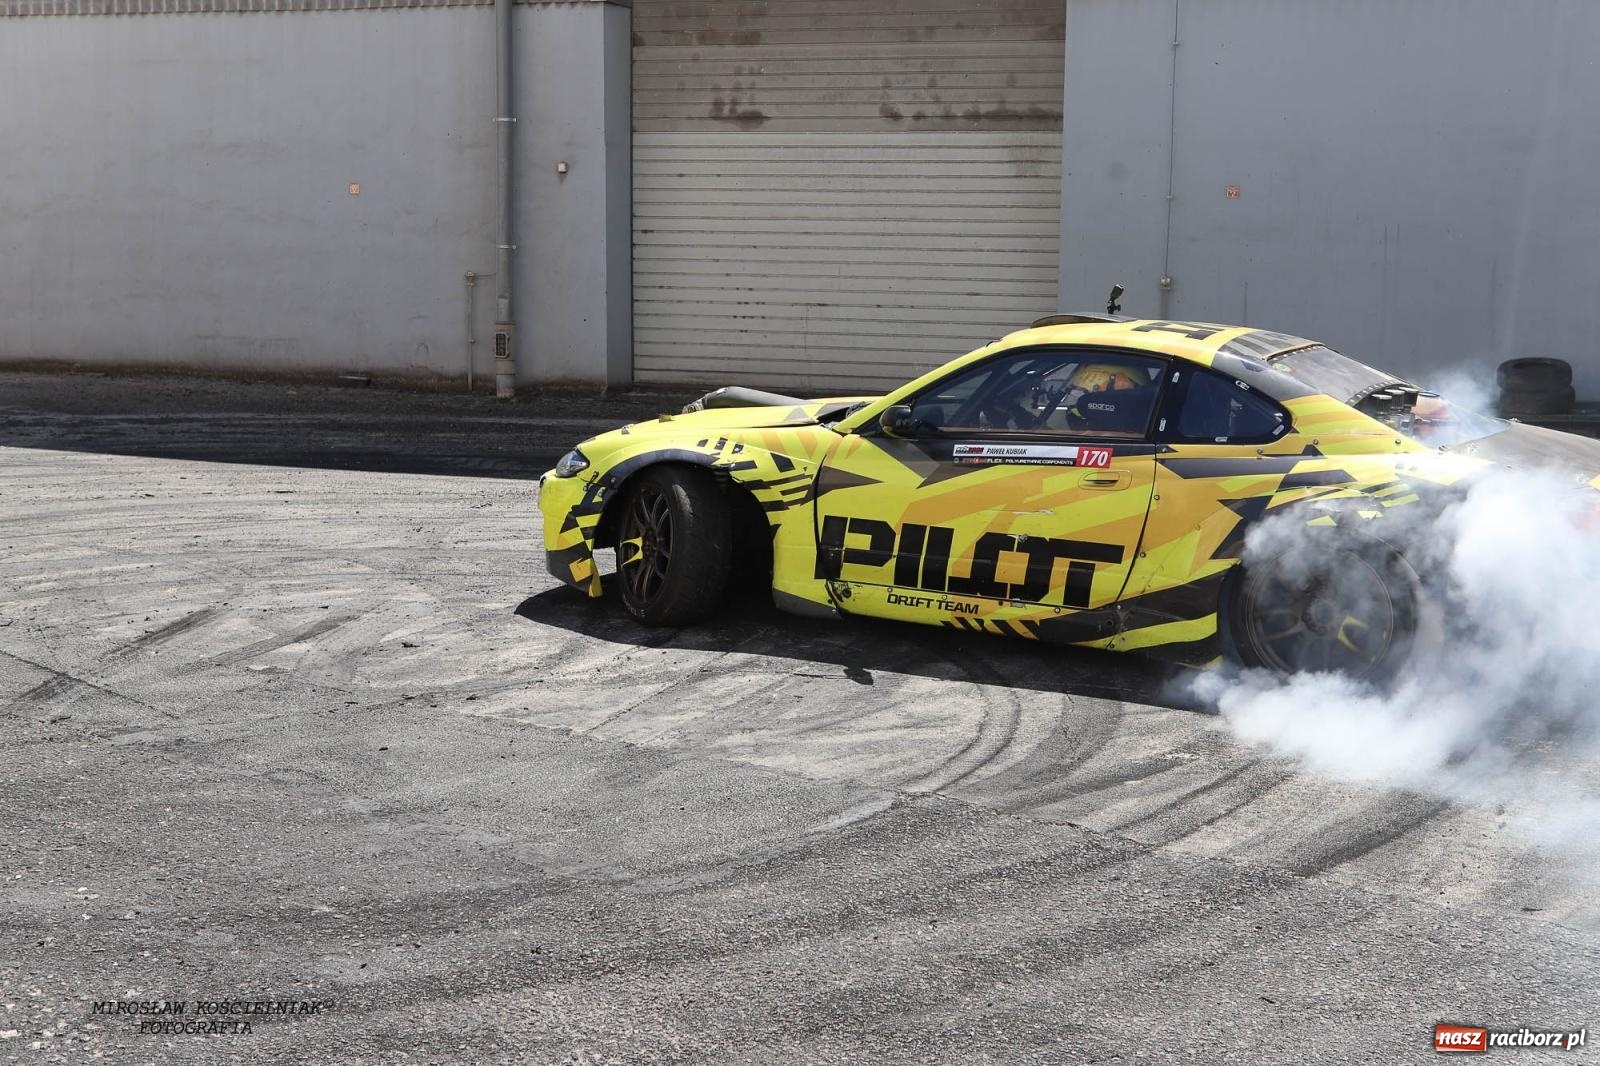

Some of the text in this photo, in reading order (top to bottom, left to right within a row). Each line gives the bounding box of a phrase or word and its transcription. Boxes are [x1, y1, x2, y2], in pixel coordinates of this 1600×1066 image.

[1088, 403, 1115, 411] sparco
[1080, 450, 1109, 467] 170
[814, 515, 1125, 608] PILOT
[887, 593, 979, 615] DRIFT TEAM
